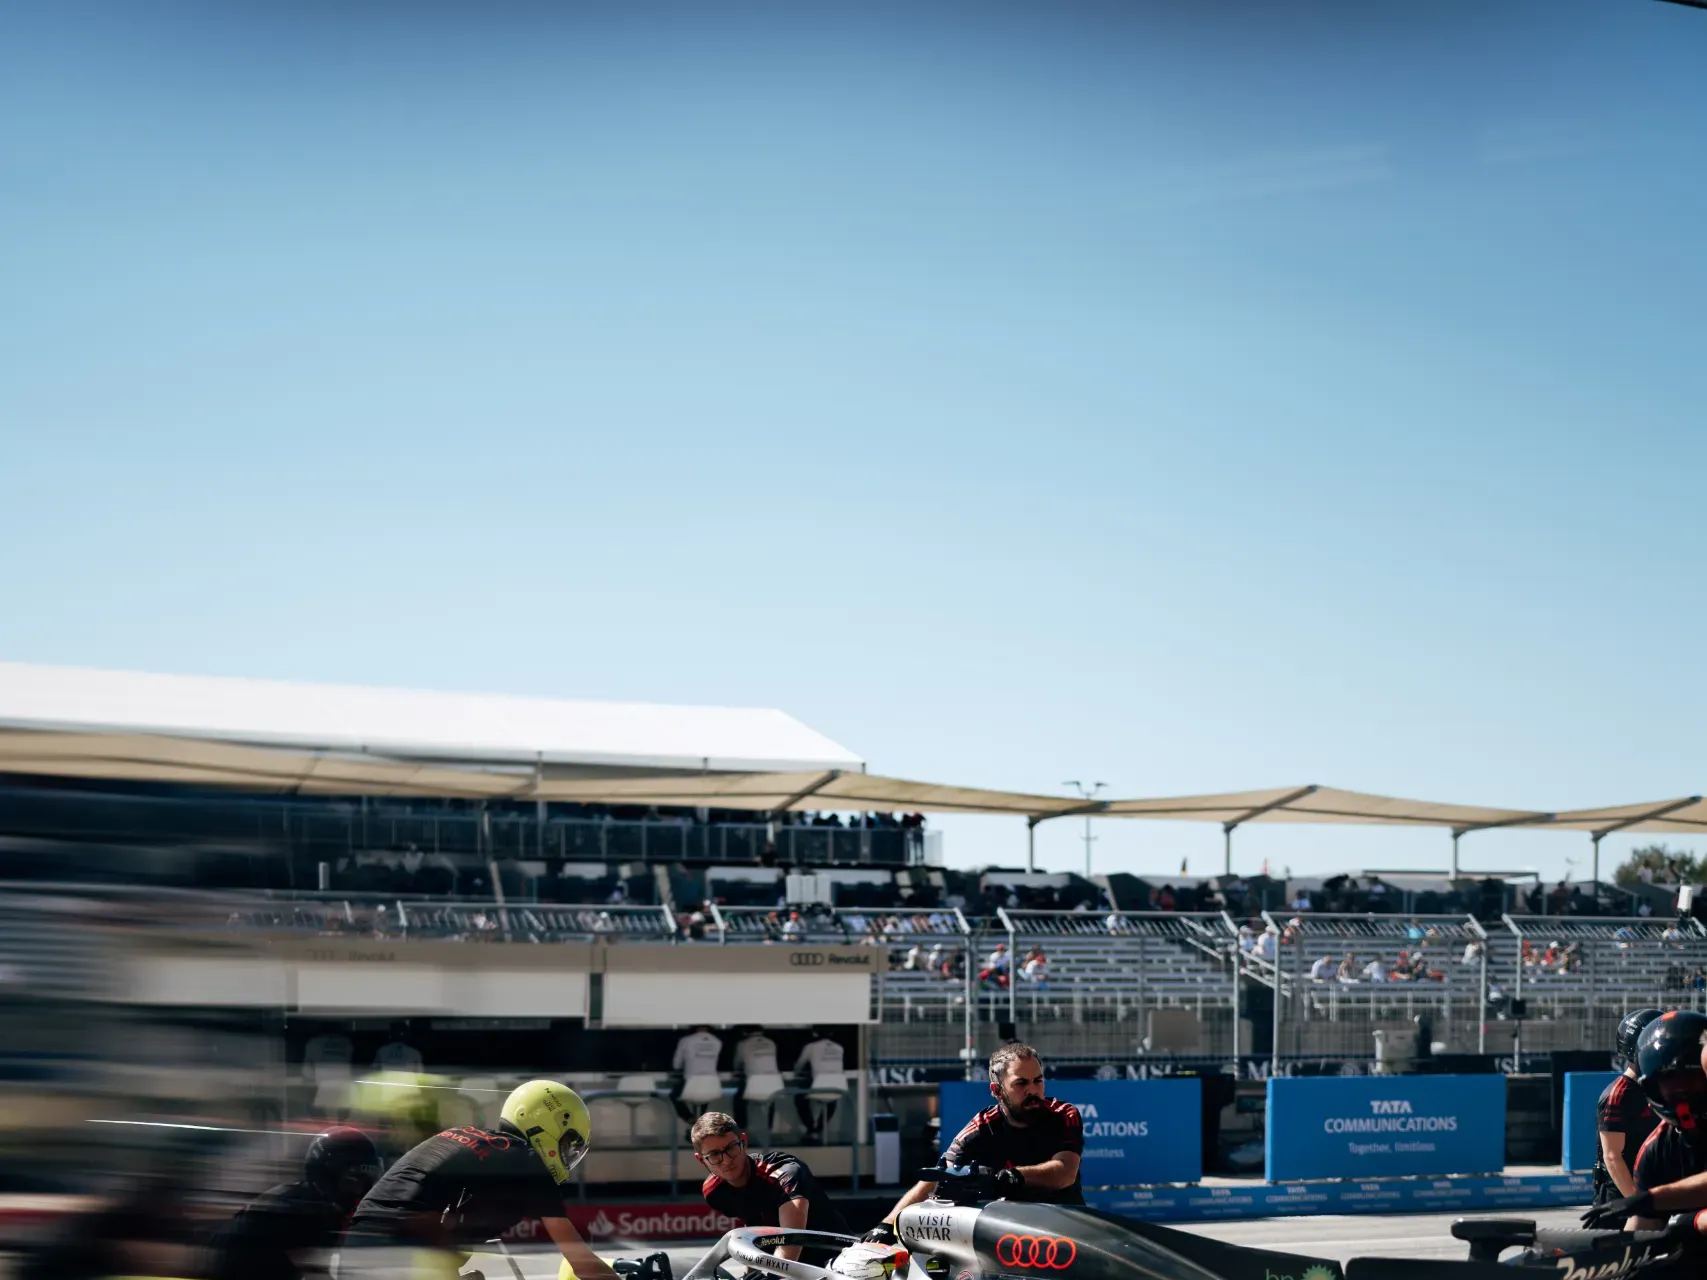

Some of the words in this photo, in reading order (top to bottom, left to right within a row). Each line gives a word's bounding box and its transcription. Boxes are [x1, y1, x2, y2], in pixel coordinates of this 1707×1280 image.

[828, 953, 870, 965] Revolut
[1370, 1100, 1413, 1114] TATA
[1324, 1116, 1457, 1134] COMMUNICATIONS
[619, 1209, 739, 1234] Santander
[918, 1212, 952, 1227] visit
[905, 1226, 951, 1242] QATAR
[755, 1256, 765, 1265] OF
[766, 1258, 790, 1271] HYATT
